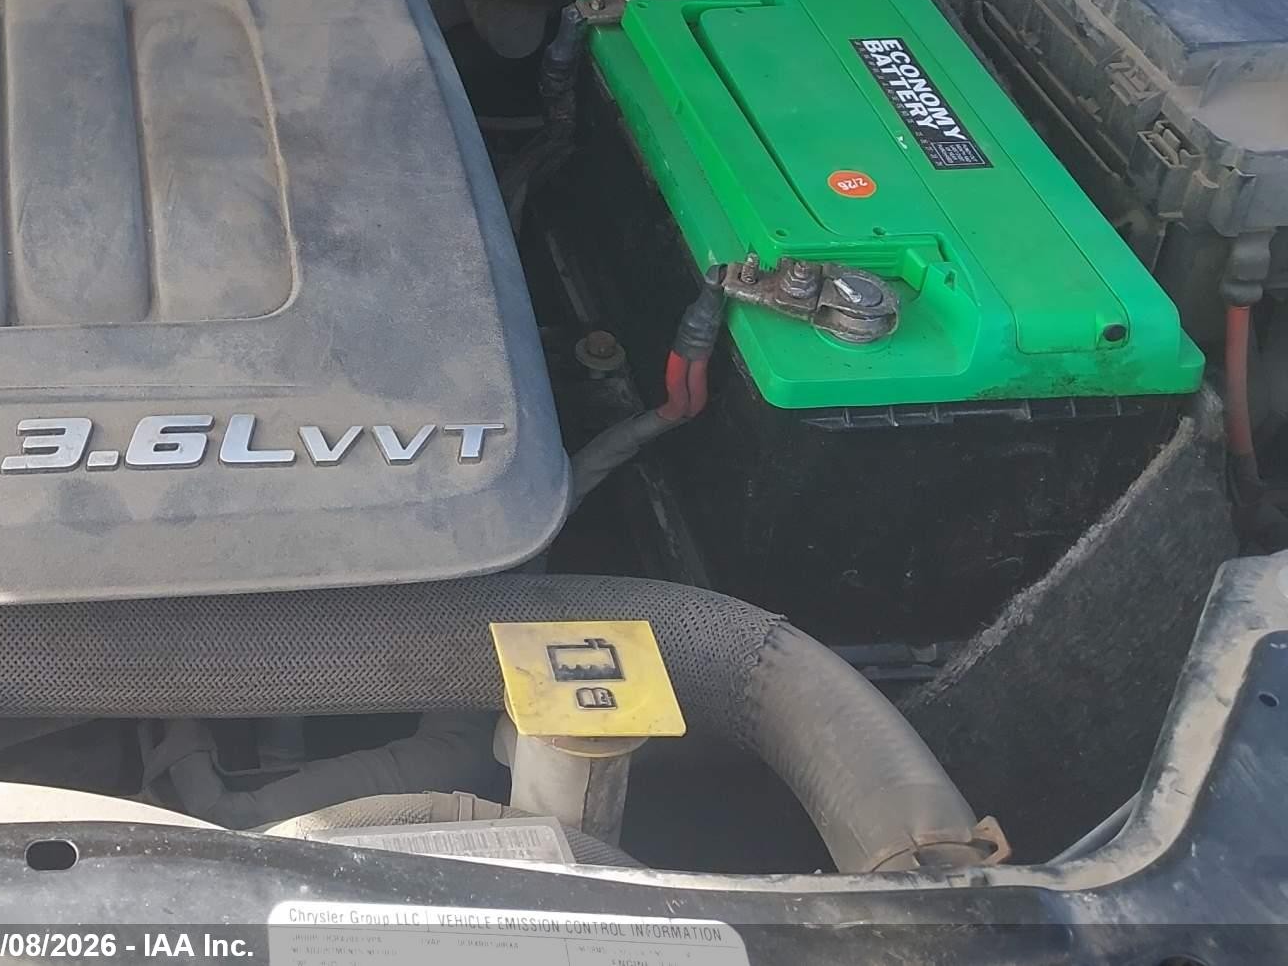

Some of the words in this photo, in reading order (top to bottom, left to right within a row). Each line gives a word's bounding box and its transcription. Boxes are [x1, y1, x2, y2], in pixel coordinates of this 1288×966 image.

[862, 40, 940, 130] BATTERY
[881, 39, 967, 140] ECONOMY
[837, 177, 868, 190] 2/26
[0, 415, 296, 474] 3.6L
[299, 423, 505, 465] VVT
[289, 907, 344, 925] Chrysler
[350, 910, 390, 927] Group
[396, 912, 420, 926] LLC
[437, 913, 492, 930] VEHICLE
[497, 916, 560, 933] EMISSION
[565, 920, 626, 937] CONTROL
[630, 923, 722, 942] INFORMATION
